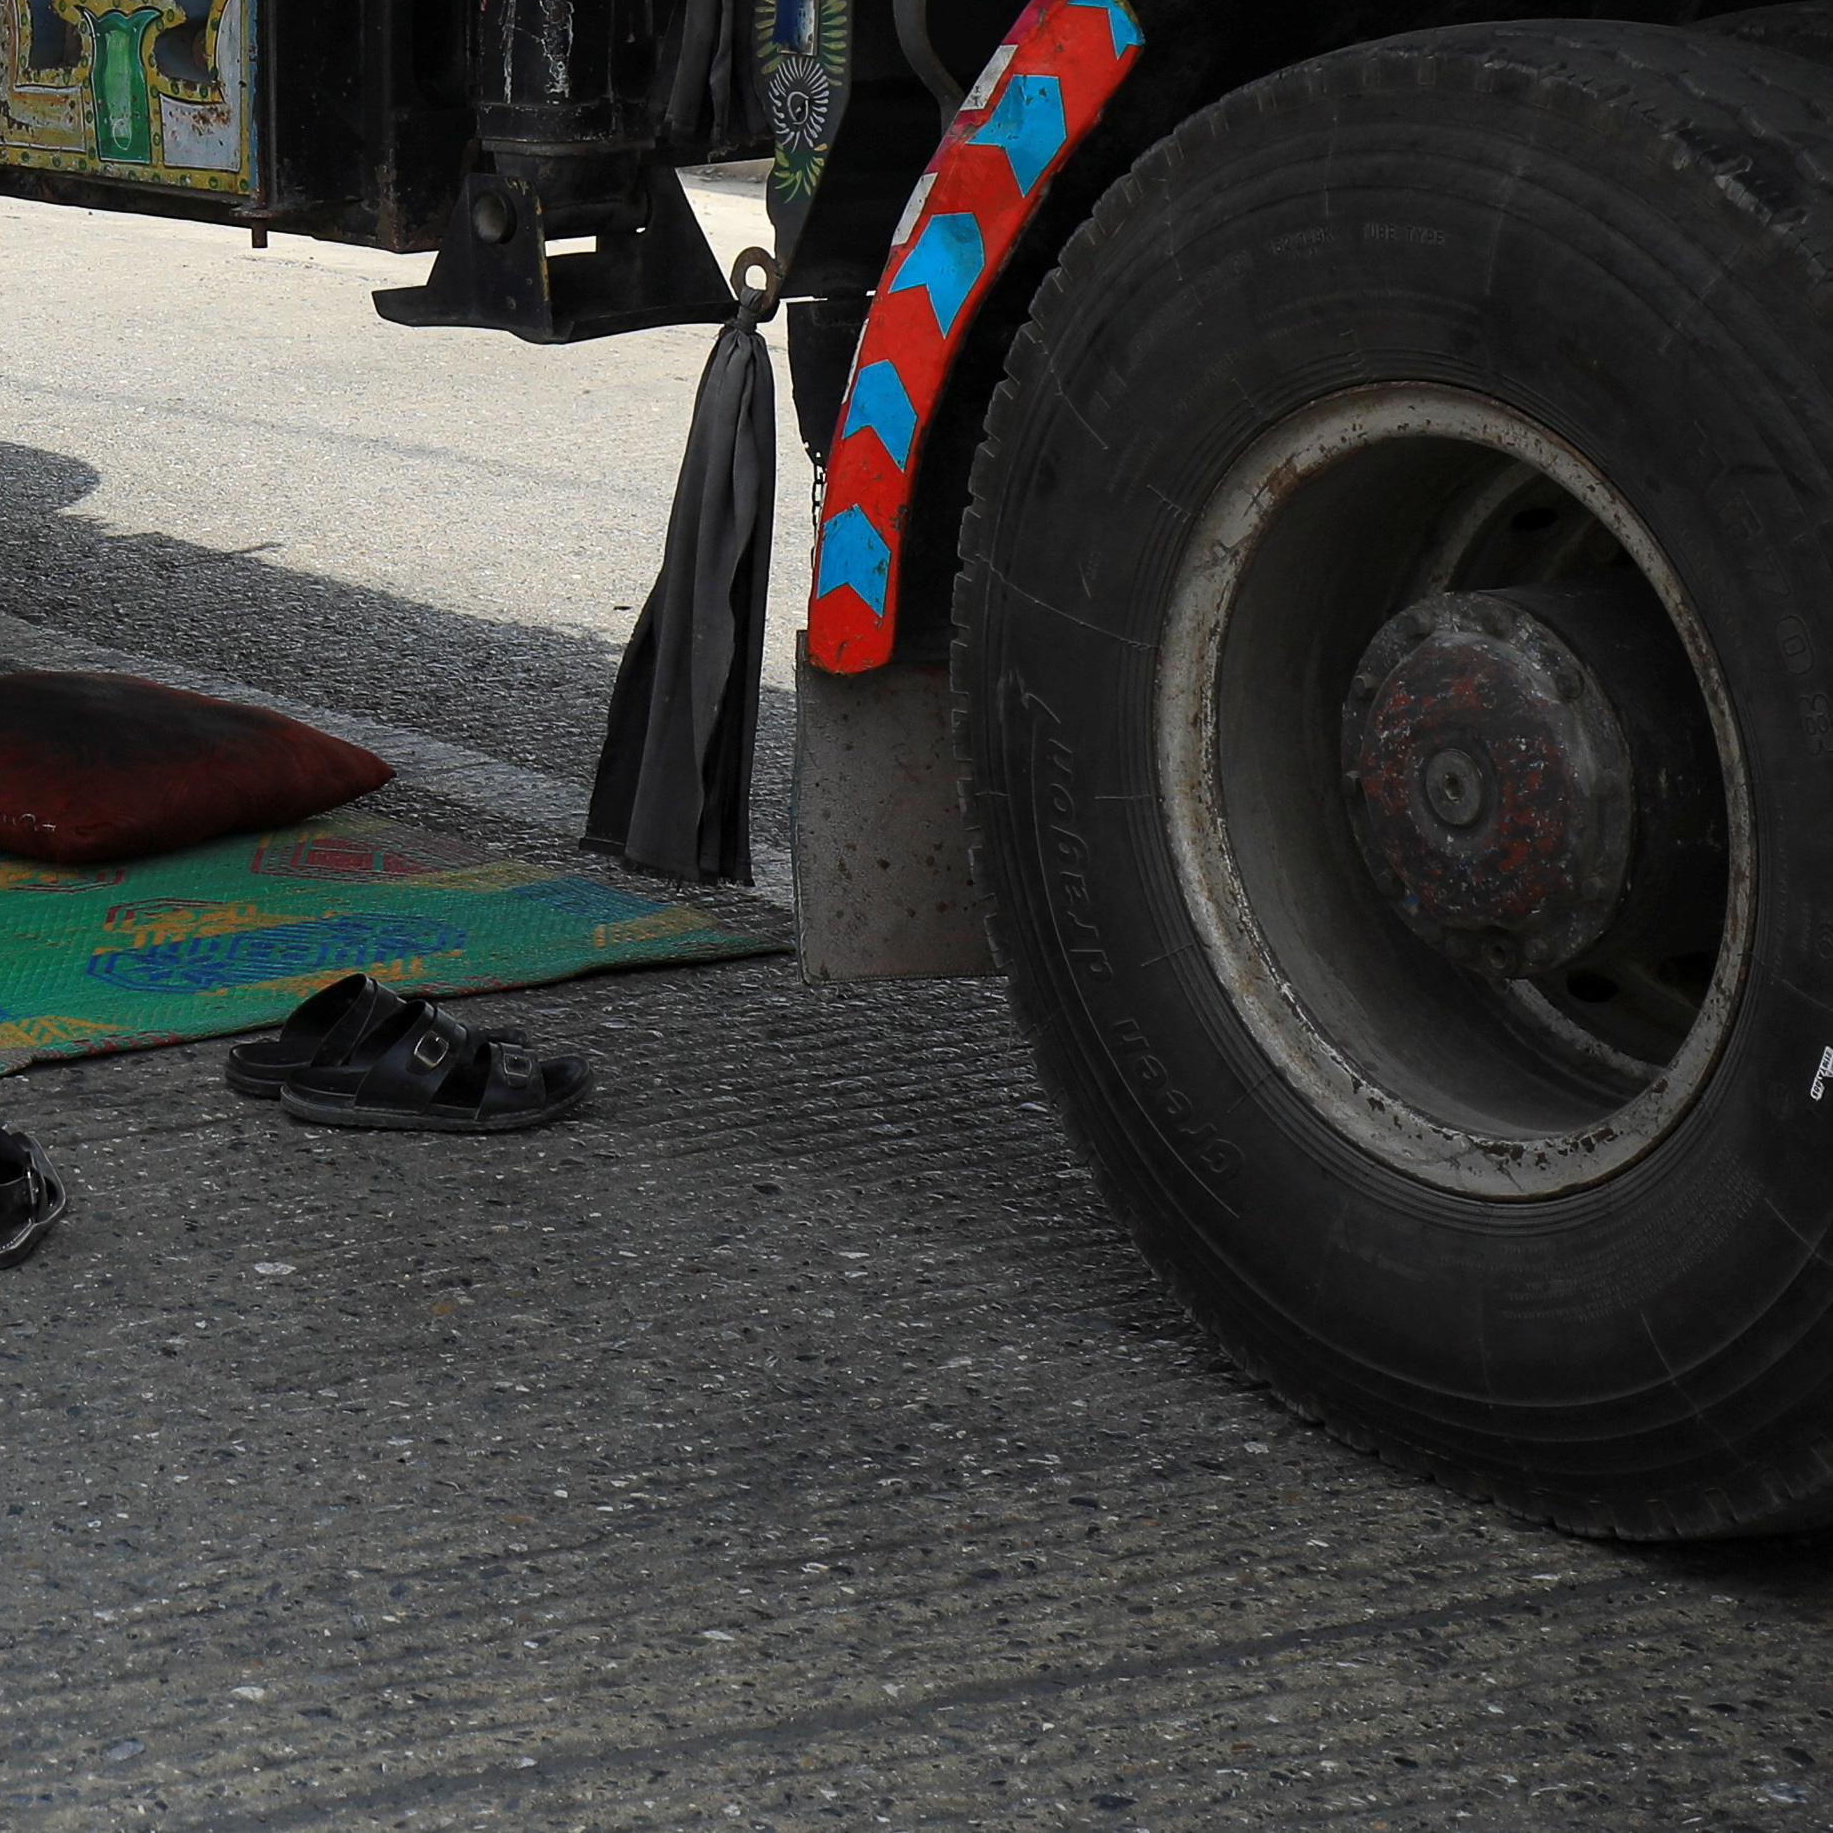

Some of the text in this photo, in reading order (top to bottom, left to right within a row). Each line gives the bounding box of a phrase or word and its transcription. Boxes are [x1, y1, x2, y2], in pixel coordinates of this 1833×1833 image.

[1405, 225, 1447, 249] TYPE
[1046, 739, 1246, 1183] Green dragon
